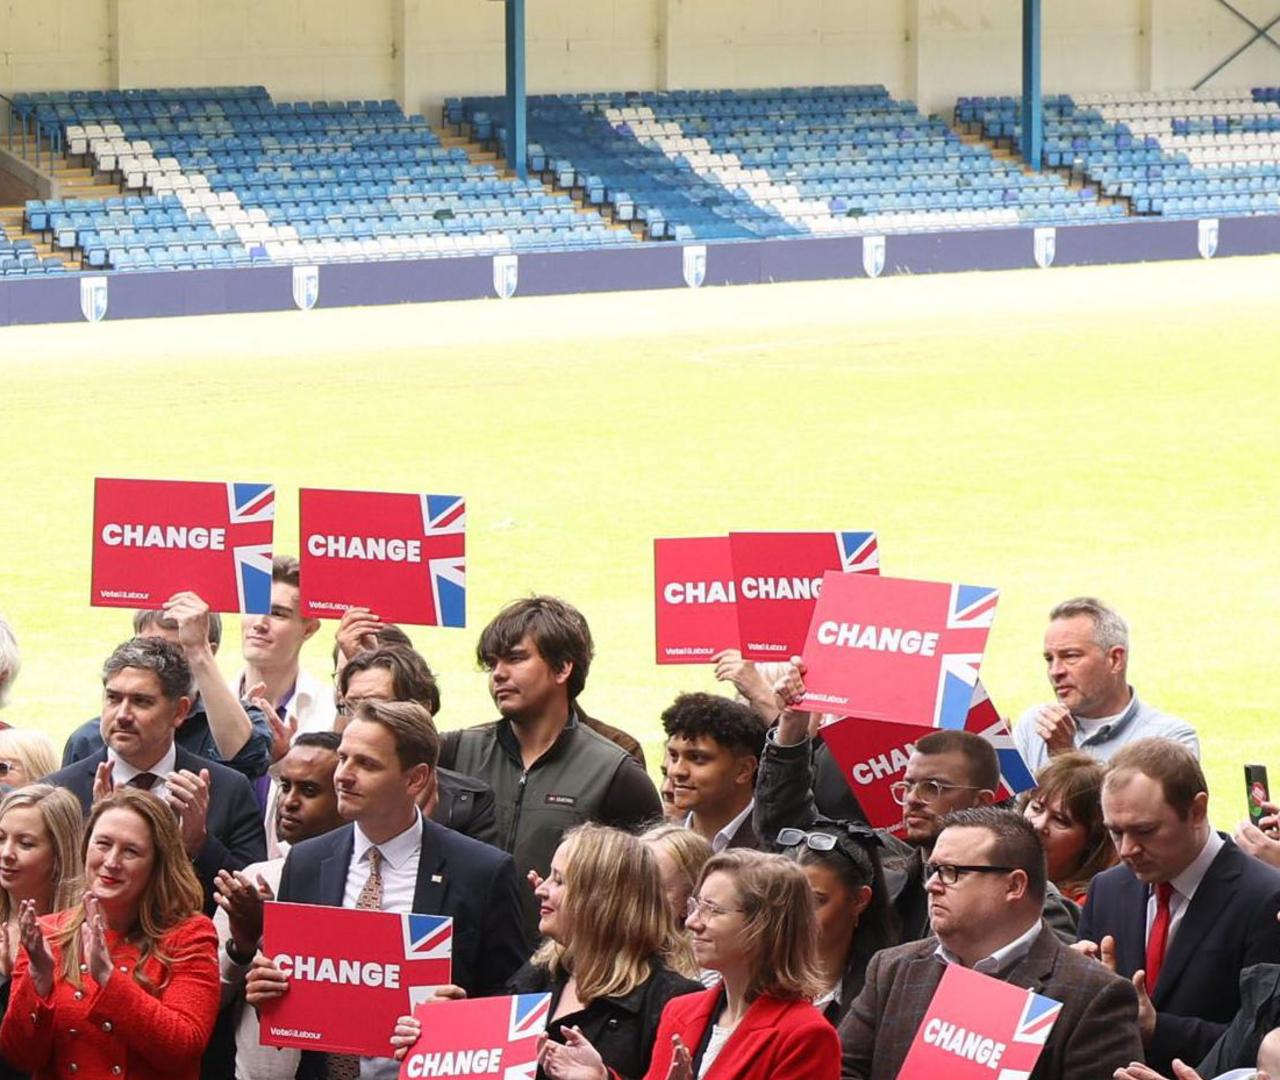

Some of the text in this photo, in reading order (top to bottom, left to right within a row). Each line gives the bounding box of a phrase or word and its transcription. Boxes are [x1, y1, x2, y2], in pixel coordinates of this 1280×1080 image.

[102, 523, 226, 551] CHANGE
[307, 534, 421, 563] CHANGE
[663, 581, 735, 604] CHA
[817, 620, 940, 657] CHANGE
[273, 953, 401, 989] CHANGE
[270, 1027, 321, 1040] Vote Labour
[923, 1017, 1007, 1071] CHANGE
[406, 1047, 504, 1079] CHANGE
